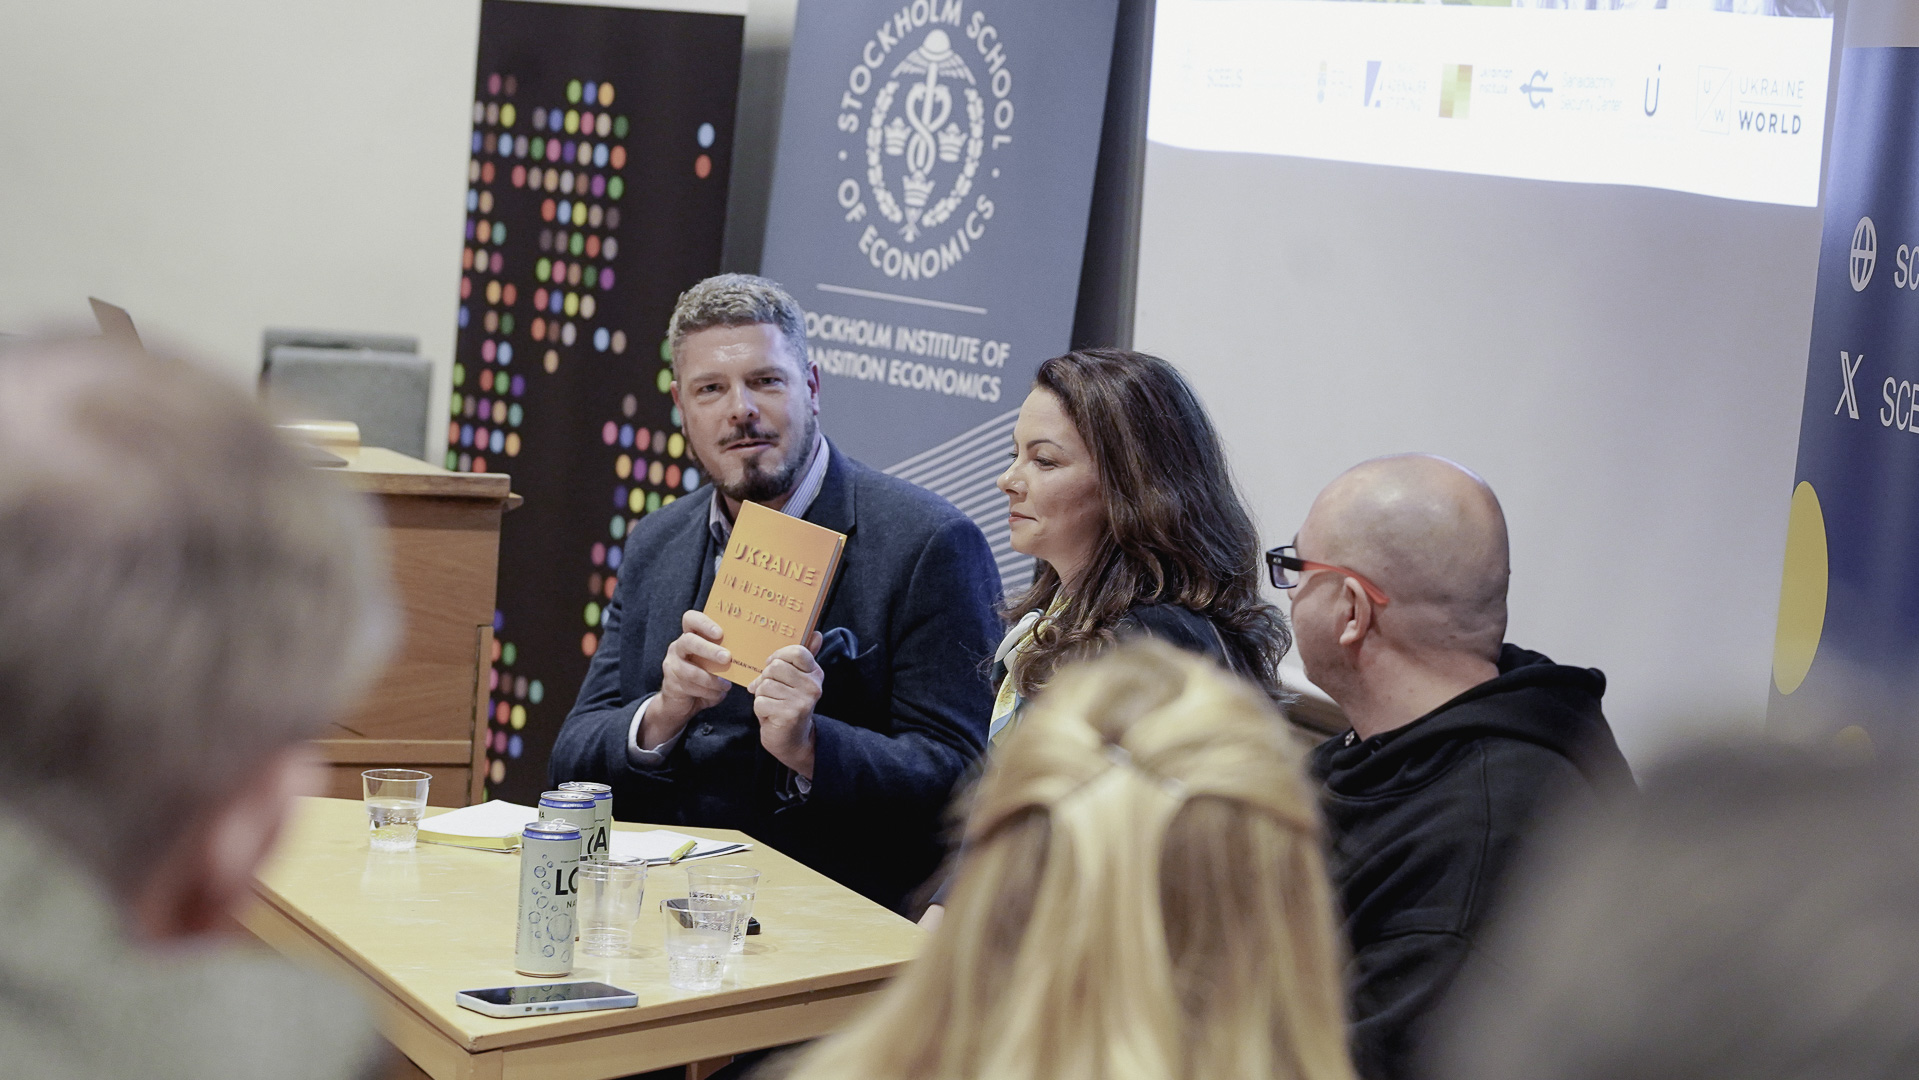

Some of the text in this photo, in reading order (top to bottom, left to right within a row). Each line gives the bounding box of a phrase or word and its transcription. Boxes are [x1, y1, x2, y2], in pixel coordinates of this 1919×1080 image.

[838, 0, 1014, 149] STOCKHOLM SCHOOL
[1738, 76, 1805, 101] UKRAINE
[1738, 109, 1802, 135] WORLD
[838, 178, 995, 281] OF ECONOMICS
[805, 311, 1011, 369] OCKHOLM INSTITUTE OF
[808, 345, 1002, 404] NSITION ECONOMICS
[734, 542, 819, 587] UKRAINE
[723, 573, 805, 613] IN HISTORIES
[715, 599, 797, 639] AND STORIES
